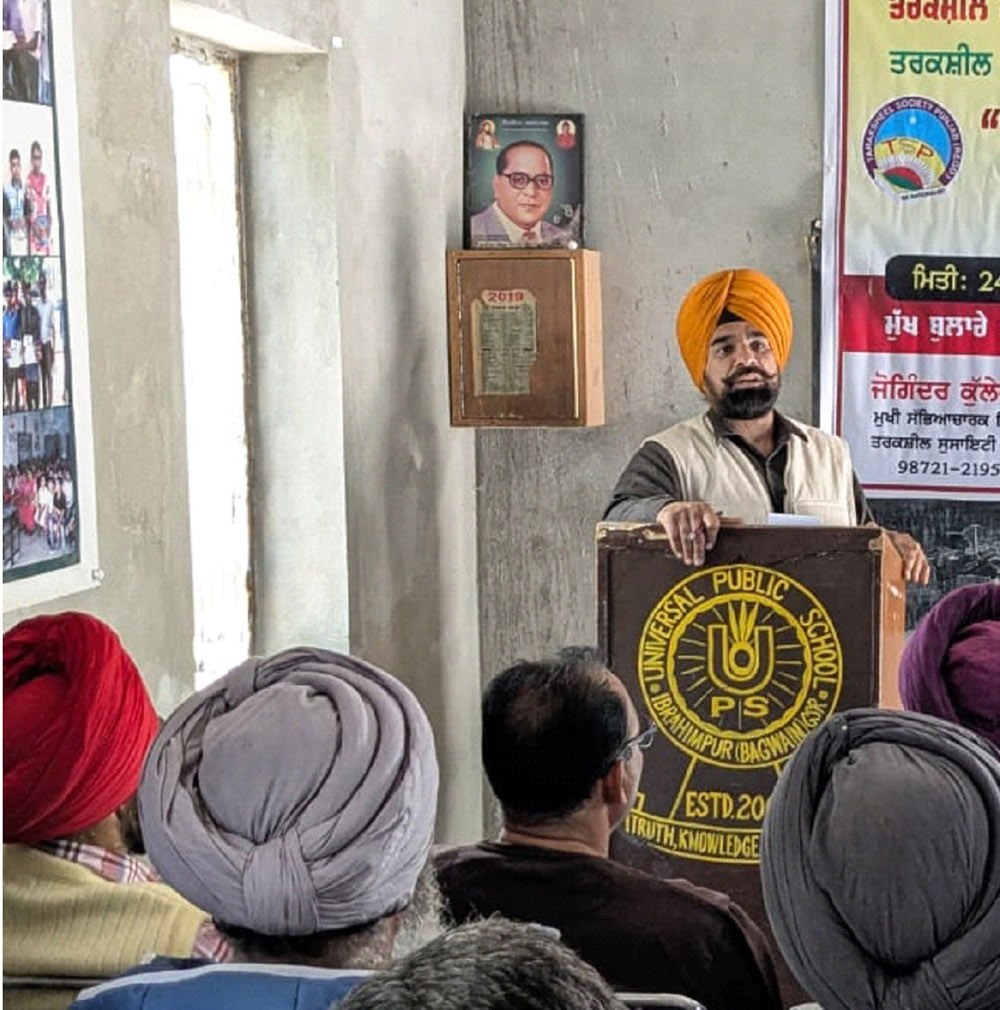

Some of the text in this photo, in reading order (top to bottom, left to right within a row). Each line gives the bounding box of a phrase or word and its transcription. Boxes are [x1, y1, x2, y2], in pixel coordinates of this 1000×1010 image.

[890, 43, 992, 77] ਤਰਕਸ਼ੀਲ
[913, 265, 967, 290] ਮਿਤੀ:
[928, 310, 988, 342] ਬੁਲਾਰੇ
[871, 372, 950, 400] ਜੋਗਿੰਦਰ
[873, 408, 901, 427] ਮੁਖੀ
[938, 435, 995, 454] ਸੁਸਾਇਟੀ
[643, 569, 838, 690] UNIVERSAL PUBLIC SCHOOL
[686, 791, 765, 820] ESTD.20
